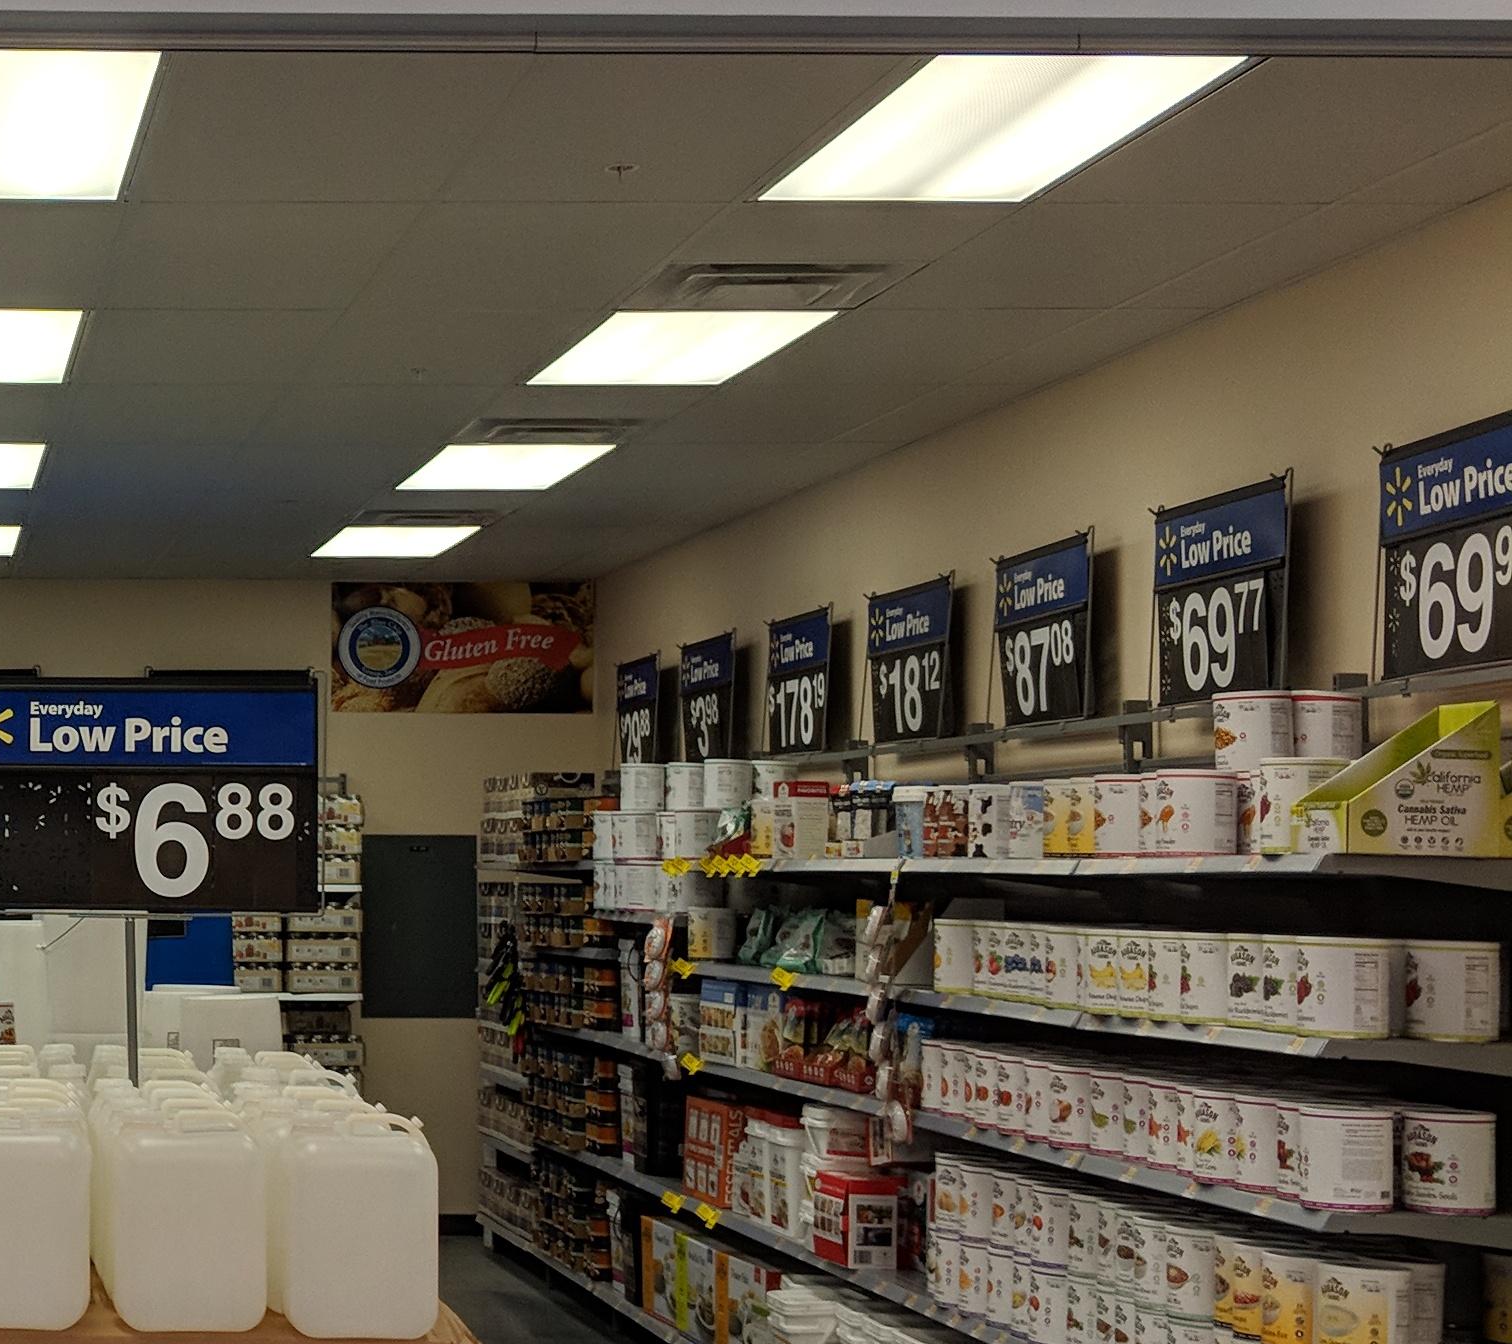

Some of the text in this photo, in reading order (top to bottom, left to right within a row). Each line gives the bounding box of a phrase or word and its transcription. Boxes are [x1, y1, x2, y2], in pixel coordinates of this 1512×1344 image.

[1417, 455, 1453, 479] Everyday
[1418, 458, 1512, 516] Low Price
[1180, 522, 1206, 539] Everyday
[1180, 525, 1252, 569] Low Price
[1013, 574, 1065, 611] Low Price
[885, 612, 930, 642] Low Price
[424, 628, 555, 663] Gluten Free
[794, 637, 814, 660] Price
[29, 700, 104, 720] Everyday
[29, 717, 229, 754] Low Price
[1425, 770, 1482, 785] California
[1437, 783, 1470, 794] HEMP
[1397, 804, 1467, 816] Cannabis Sativa
[1404, 815, 1459, 827] HEMP OIL
